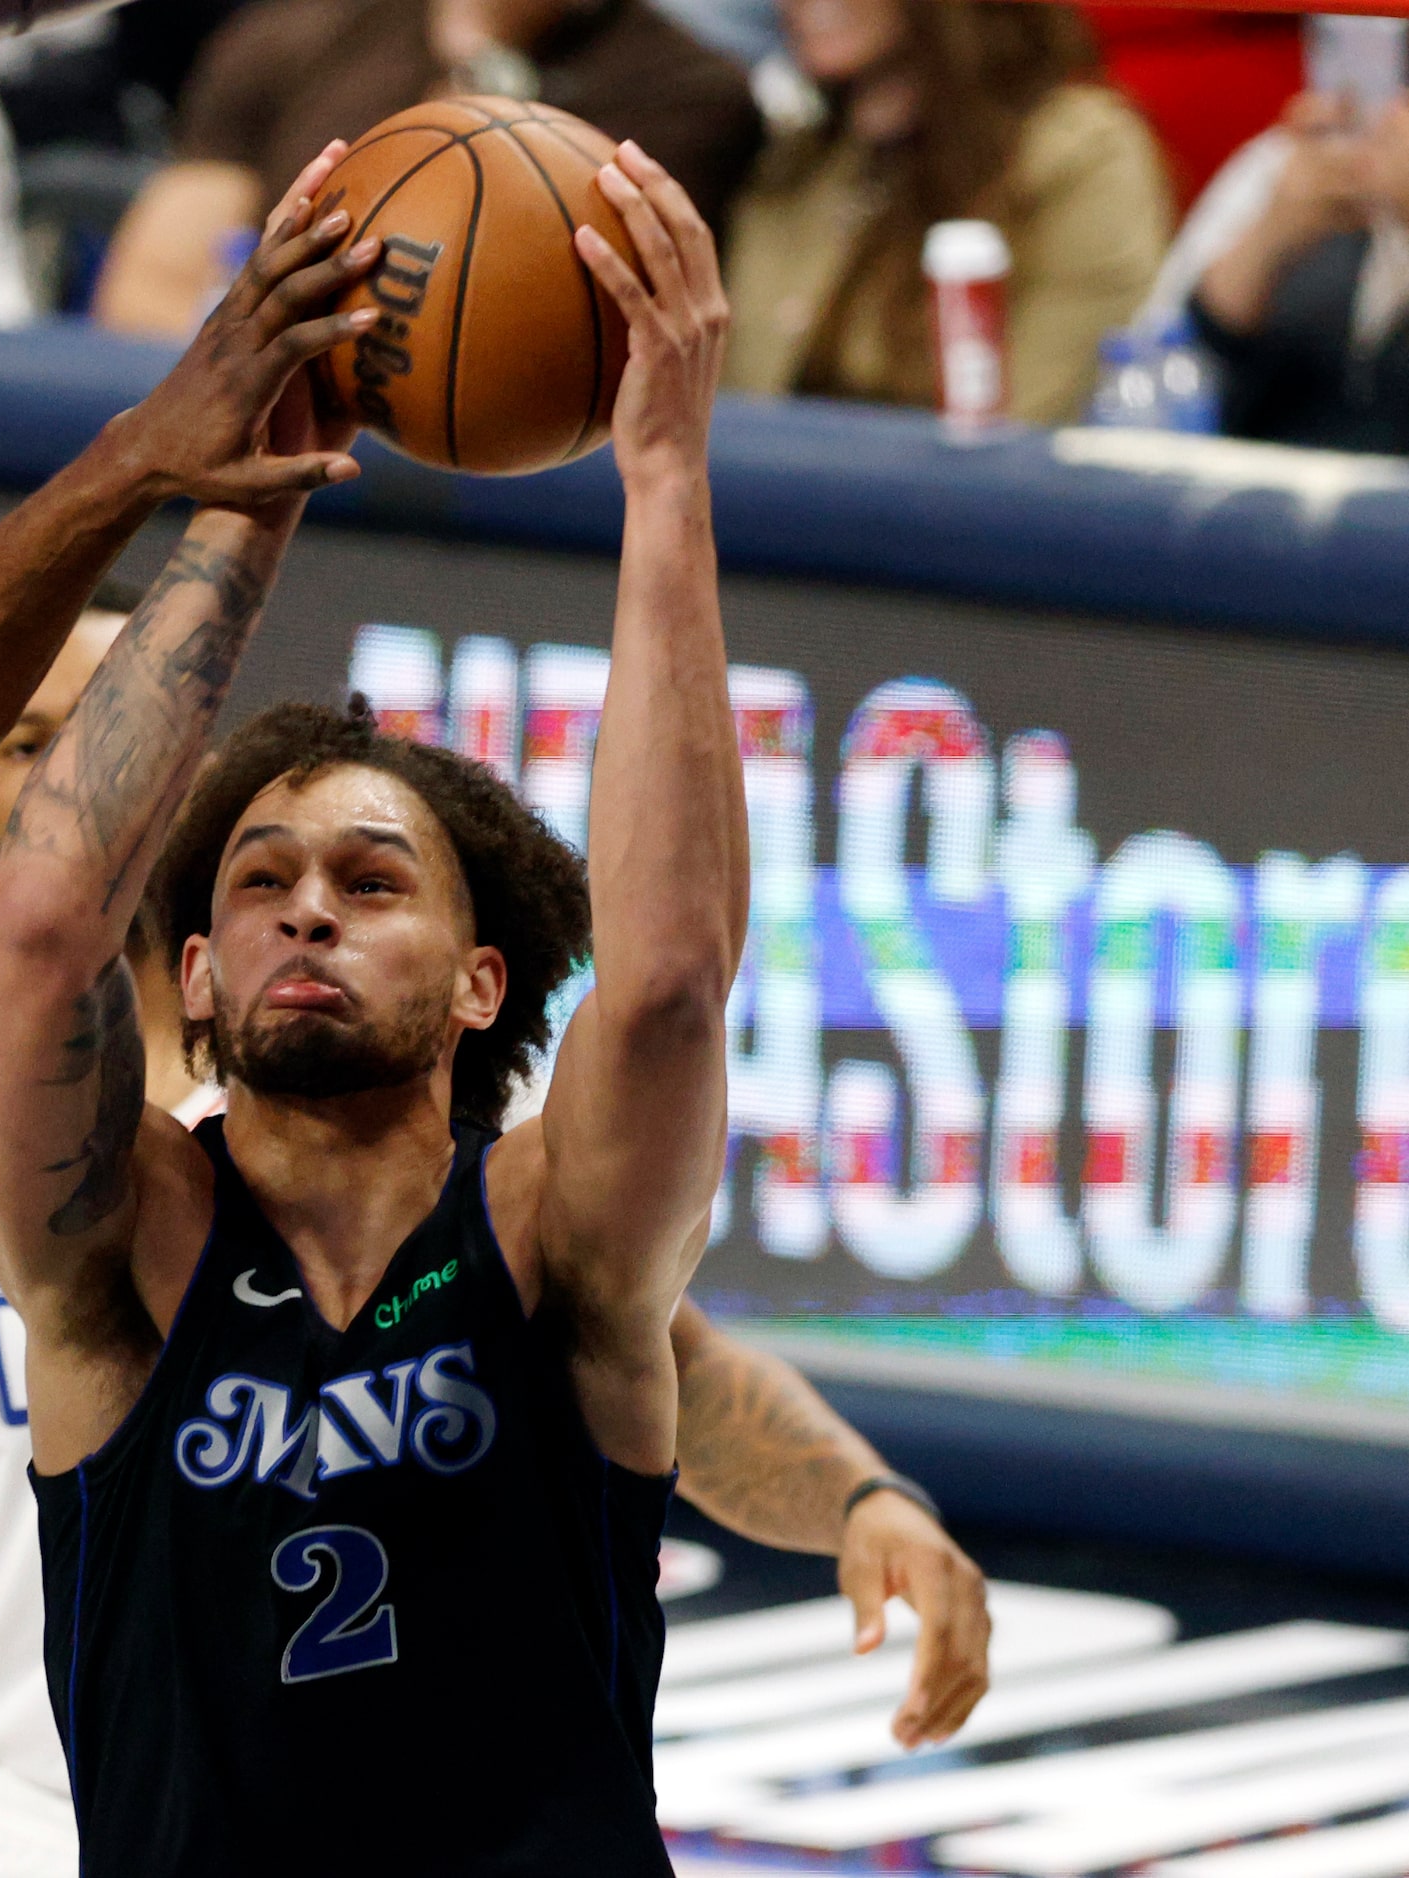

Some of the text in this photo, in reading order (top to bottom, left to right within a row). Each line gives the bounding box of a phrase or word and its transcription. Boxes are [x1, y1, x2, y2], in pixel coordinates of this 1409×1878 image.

[375, 1258, 459, 1329] Chime
[175, 1339, 497, 1499] MAVS
[271, 1524, 398, 1684] 2
